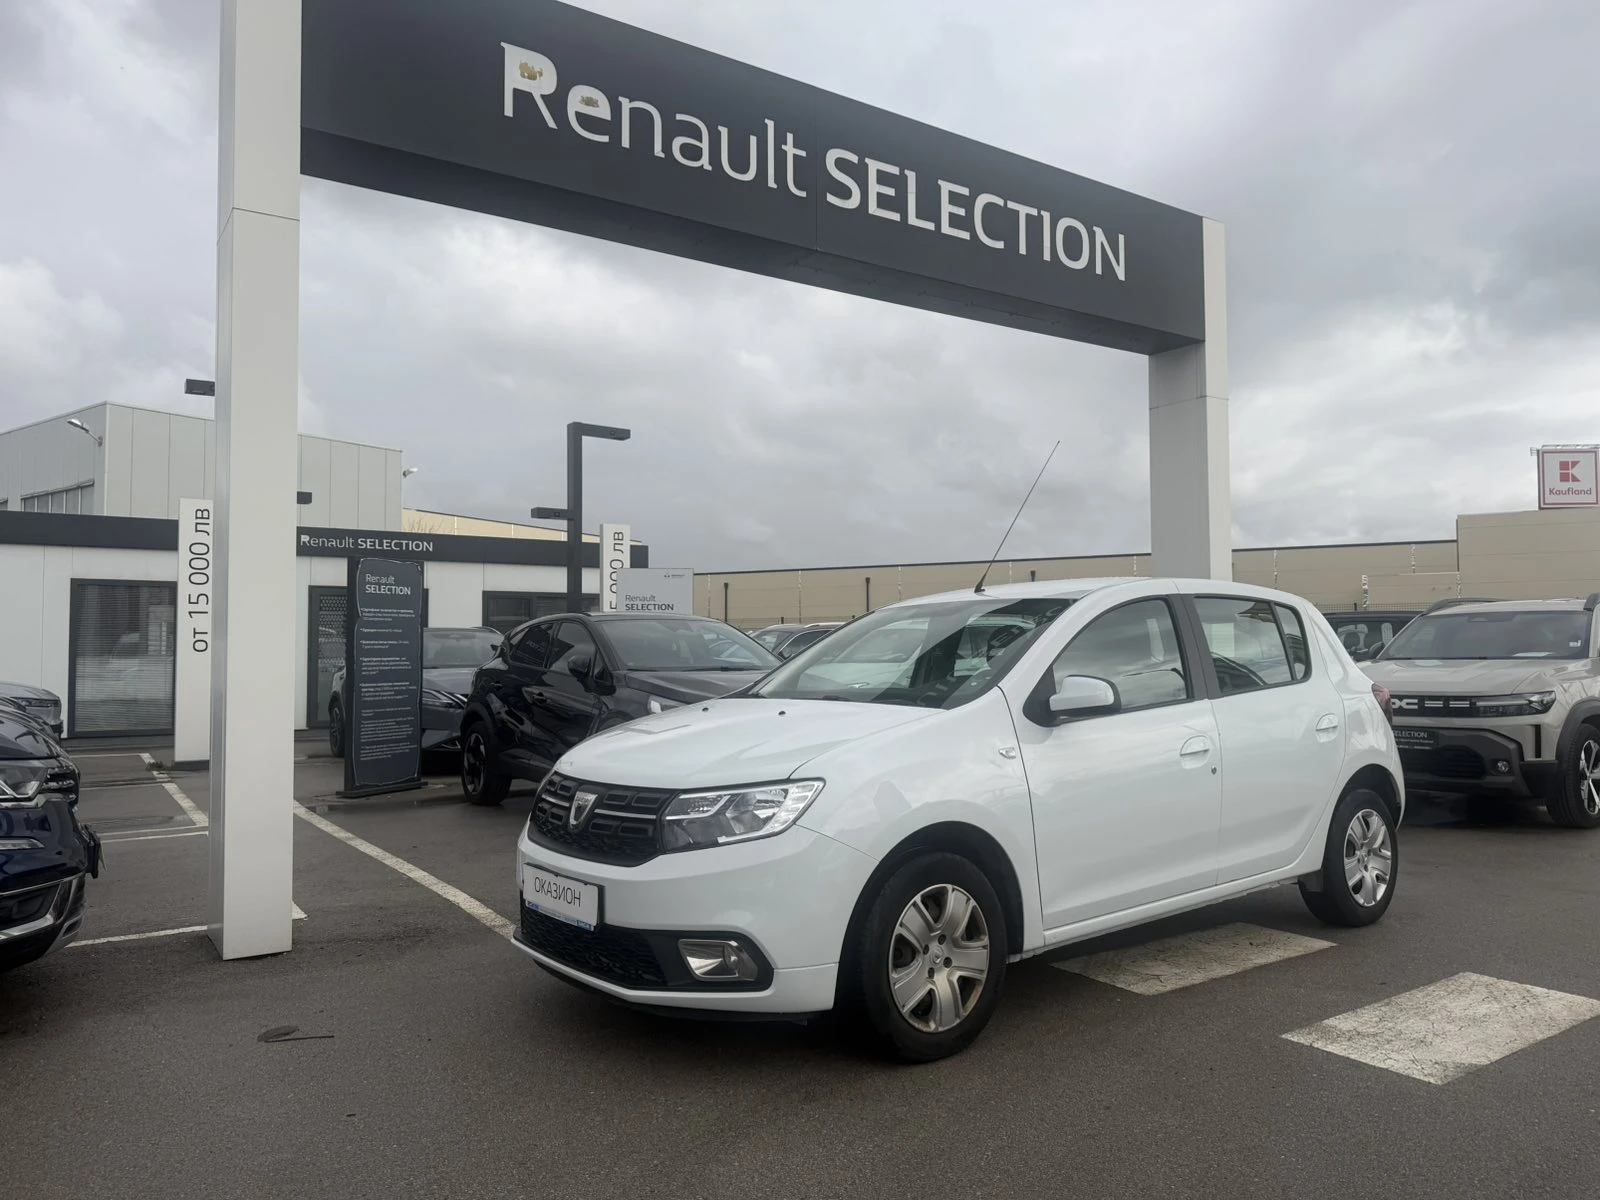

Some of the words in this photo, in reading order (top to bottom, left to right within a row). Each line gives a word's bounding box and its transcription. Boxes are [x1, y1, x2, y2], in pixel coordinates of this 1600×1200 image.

[501, 42, 806, 197] Renault
[825, 148, 1126, 282] SELECTION
[1548, 487, 1592, 496] Kaufland
[300, 534, 354, 549] Renault
[357, 538, 433, 552] SELECTION
[188, 542, 210, 586] 000
[365, 573, 395, 584] Renault
[365, 584, 411, 595] SELECTION
[625, 594, 656, 602] Renault
[187, 592, 209, 619] 15
[625, 603, 674, 611] SELECTION
[534, 877, 581, 907] ОКАЗИОН
